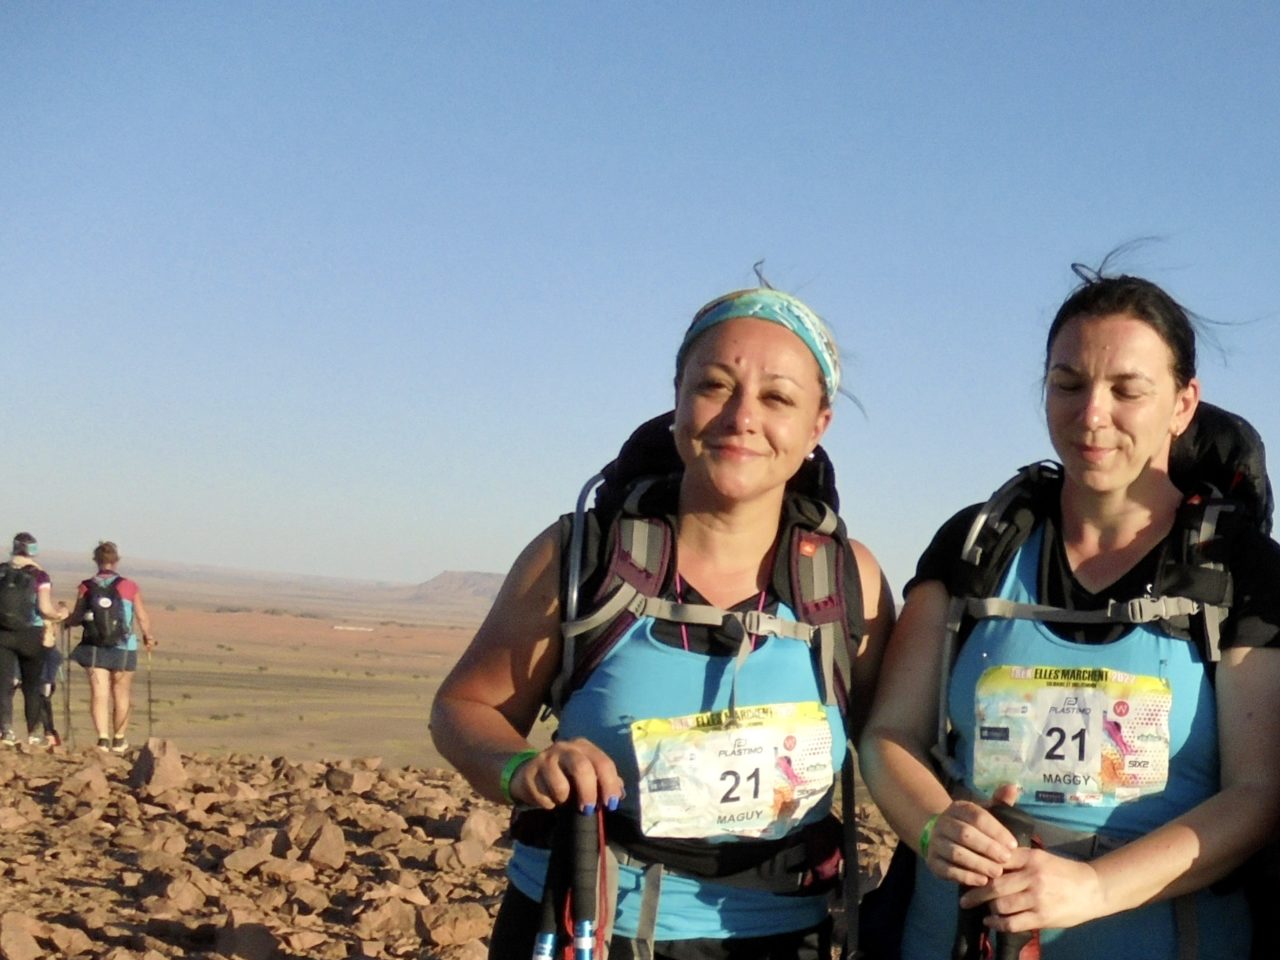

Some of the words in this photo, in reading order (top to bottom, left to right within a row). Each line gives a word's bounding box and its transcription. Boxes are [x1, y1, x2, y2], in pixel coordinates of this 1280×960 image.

[1034, 668, 1059, 680] ELLES
[1060, 668, 1108, 682] MARCHENT
[1049, 706, 1092, 715] PLASTIMO
[1045, 727, 1087, 761] 21
[718, 746, 763, 757] PLASTIMO
[719, 767, 761, 804] 21
[1043, 773, 1092, 786] MAGGY
[716, 810, 764, 825] MAGUY
